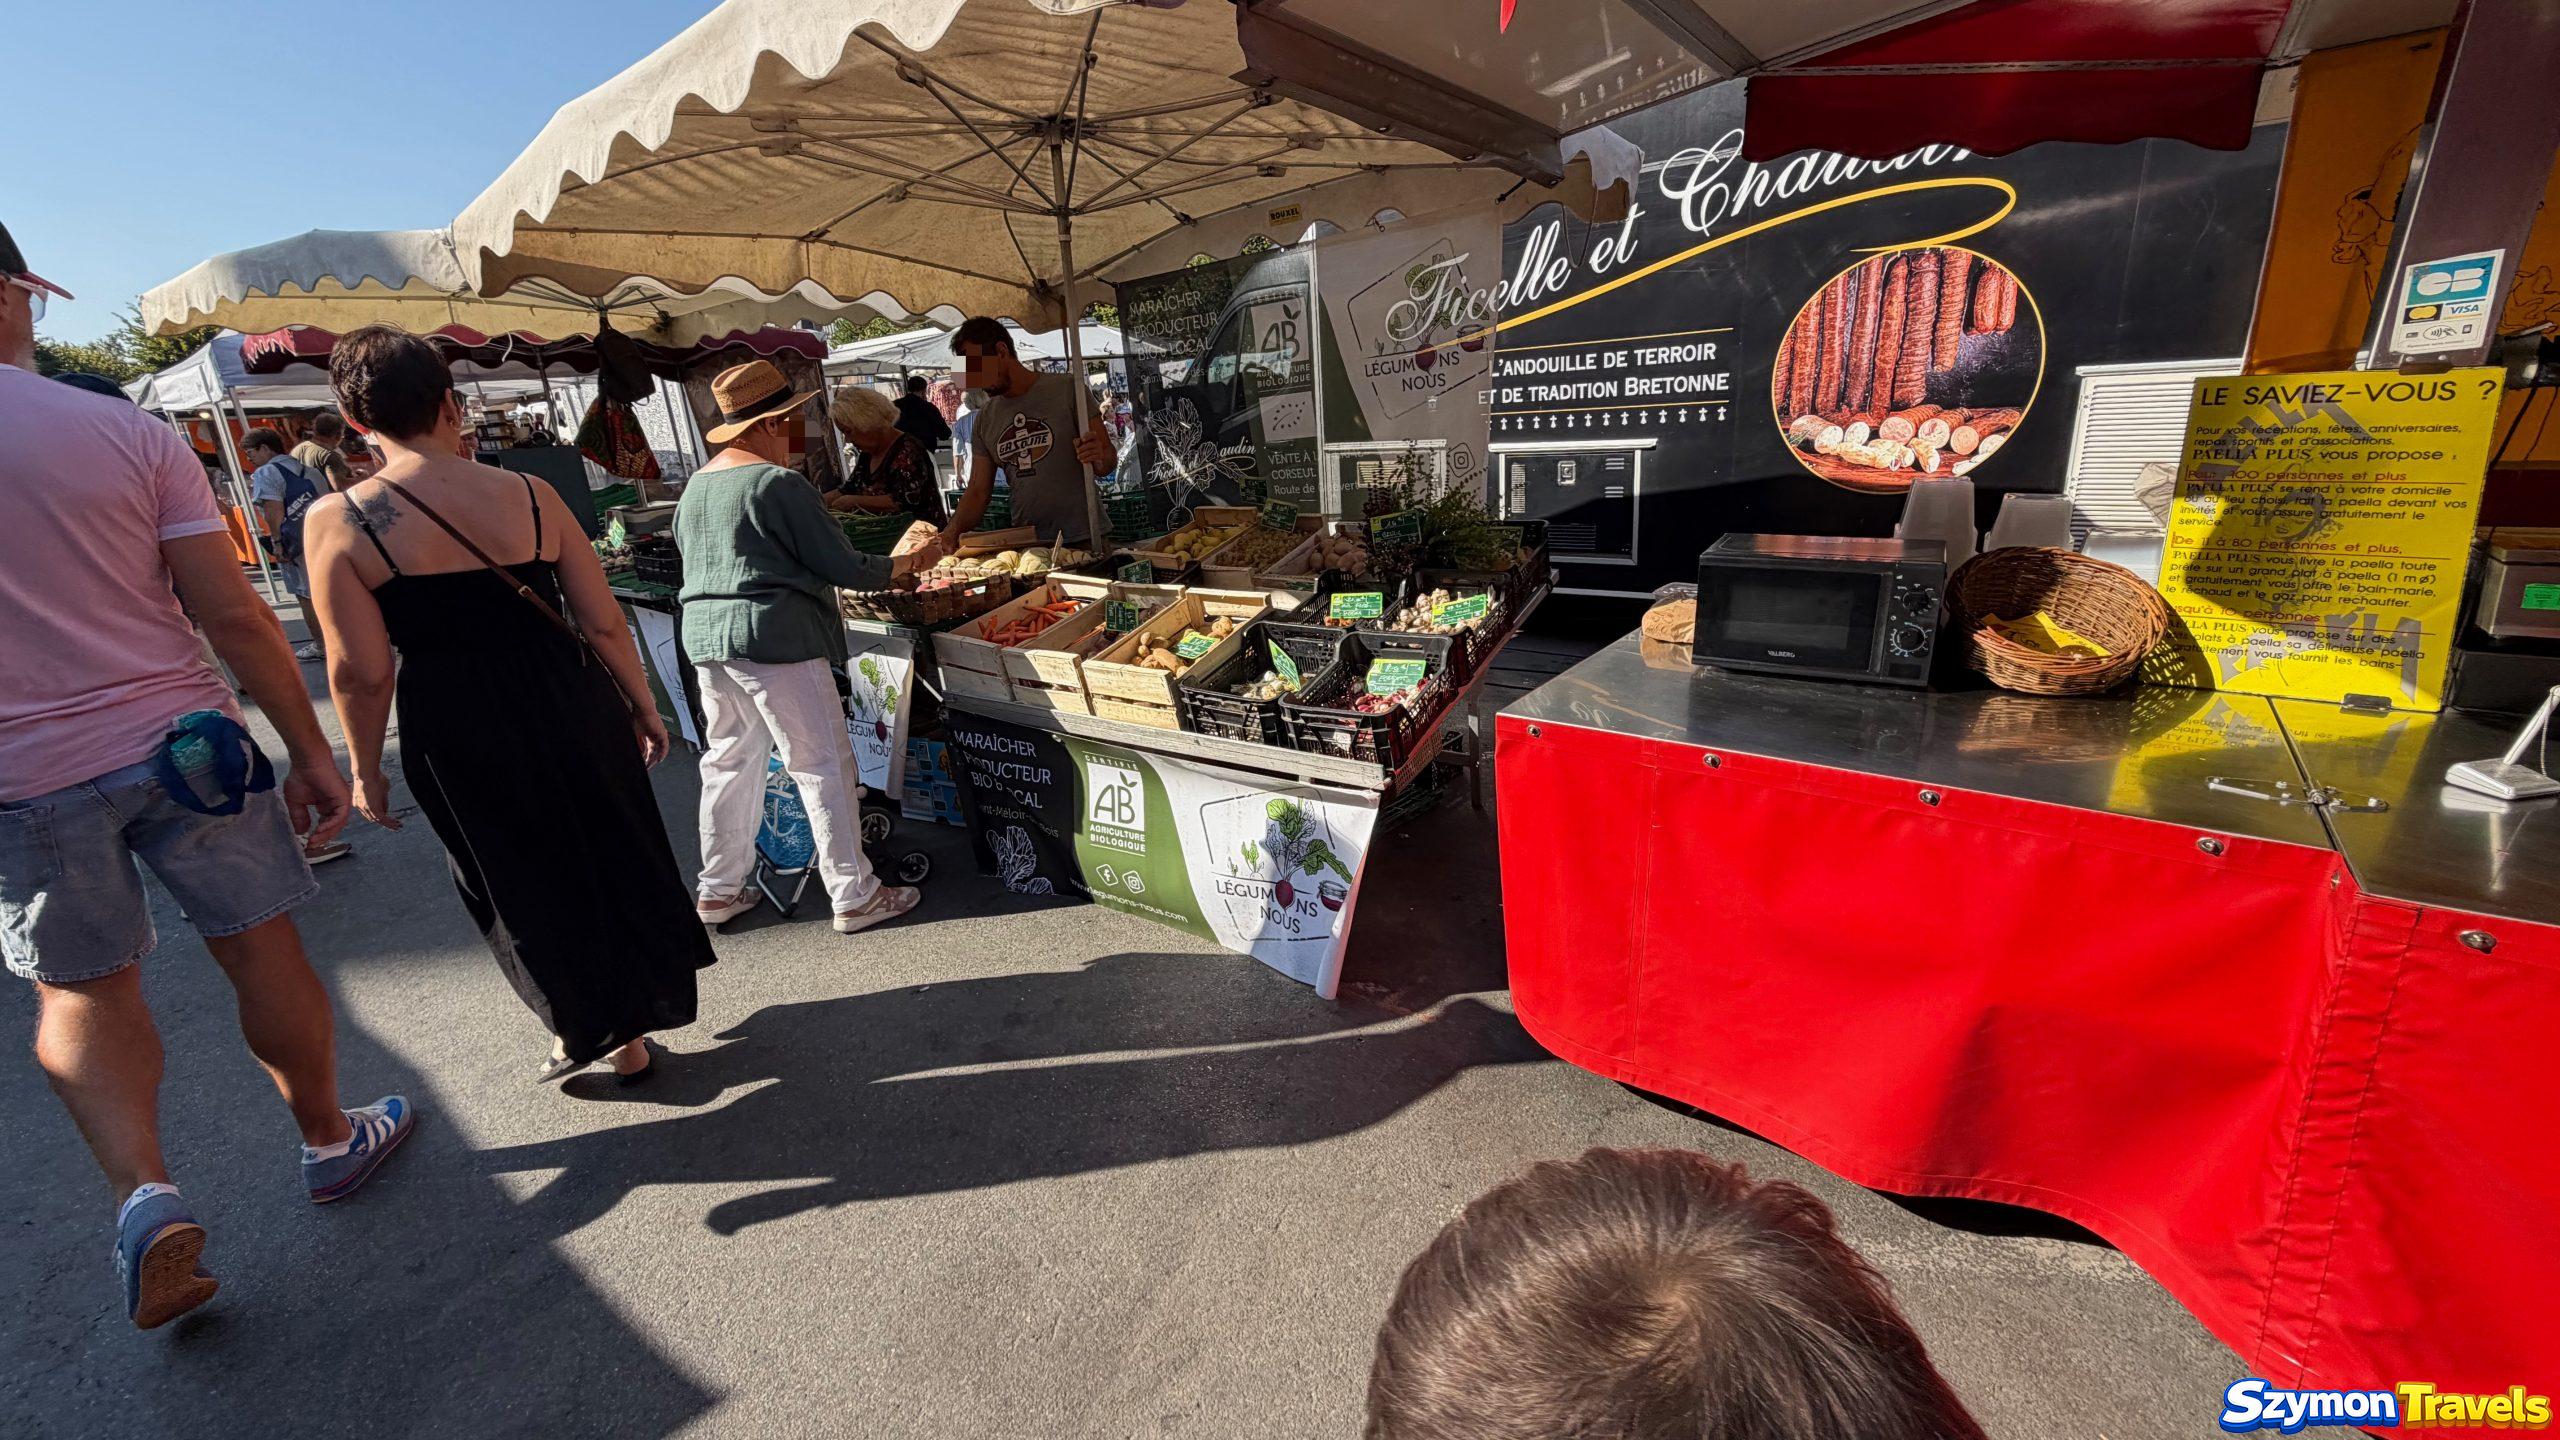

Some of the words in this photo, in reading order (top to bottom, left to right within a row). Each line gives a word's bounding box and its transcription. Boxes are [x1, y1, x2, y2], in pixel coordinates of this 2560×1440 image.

[1270, 208, 1299, 220] ROUXEL
[1386, 220, 1572, 342] Ficelle
[1589, 203, 1645, 274] et
[2417, 267, 2485, 296] CB
[2451, 304, 2479, 314] VISA
[1134, 311, 1219, 338] PRODUCTEUR
[1138, 348, 1158, 361] BIO
[1169, 337, 1213, 355] LOCAL
[1490, 353, 1597, 377] L'ANDOUILLE
[1603, 351, 1628, 368] DE
[1634, 342, 1717, 365] TERROIR
[1402, 373, 1446, 391] NOUS
[1479, 389, 1497, 405] ET
[1502, 387, 1523, 403] DE
[1528, 381, 1617, 402] TRADITION
[2201, 387, 2230, 406] LE
[2243, 381, 2458, 405] SAVIEZ-VOUS
[2478, 380, 2498, 401] ?
[2196, 426, 2223, 435] Pour
[2251, 424, 2322, 436] réceptions,
[2328, 424, 2362, 434] fêtes,
[2368, 424, 2463, 434] anniversaires,
[2194, 438, 2226, 448] repas
[2231, 436, 2275, 448] sportifs
[2281, 437, 2294, 446] et
[2299, 435, 2395, 446] d'associations.
[1268, 452, 1301, 465] VENTE
[2192, 449, 2257, 460] PAELLA
[2266, 448, 2312, 460] PLUS
[2319, 450, 2359, 460] vous
[2367, 451, 2443, 463] propose
[1271, 468, 1317, 480] CORSEUL
[2230, 470, 2260, 480] 100
[2266, 471, 2345, 483] personnes
[2352, 471, 2367, 480] et
[2375, 471, 2407, 483] plus
[1274, 486, 1300, 496] Route
[1302, 484, 1315, 495] de
[2186, 482, 2235, 492] PAELLA
[2240, 483, 2274, 492] PLUS
[2299, 484, 2330, 493] rend
[2336, 485, 2345, 494] à
[2352, 486, 2386, 495] votre
[2392, 486, 2453, 496] domicile
[2225, 495, 2245, 504] lieu
[2251, 495, 2290, 506] choisi,
[2295, 495, 2315, 506] fait
[2321, 497, 2333, 506] la
[2338, 496, 2382, 508] paella
[2388, 498, 2437, 509] devant
[2444, 500, 2468, 509] vos
[2180, 505, 2216, 515] invités
[2222, 507, 2235, 515] et
[2240, 508, 2267, 516] vous
[2273, 508, 2313, 518] assure
[2319, 507, 2407, 521] gratuitement
[2412, 510, 2425, 520] le
[2176, 536, 2194, 545] De
[2217, 537, 2226, 547] à
[2232, 538, 2252, 548] 80
[2258, 540, 2337, 553] personnes
[2345, 543, 2361, 552] et
[2367, 543, 2402, 555] plus,
[2173, 550, 2222, 562] PAELLA
[2228, 553, 2260, 563] PLUS
[2266, 556, 2295, 565] vous
[2299, 555, 2326, 566] livre
[2332, 557, 2344, 567] la
[2351, 558, 2393, 570] paella
[2400, 560, 2436, 571] toute
[2206, 565, 2223, 573] sur
[2248, 566, 2286, 578] grand
[2291, 566, 2317, 579] plat
[2322, 568, 2331, 578] à
[2337, 570, 2380, 583] paella
[2403, 574, 2416, 583] m
[2169, 574, 2180, 583] et
[2186, 575, 2261, 589] gratuitement
[2267, 580, 2296, 589] vous
[2302, 580, 2332, 591] offre
[2338, 583, 2350, 592] le
[2357, 583, 2437, 598] bain-marie,
[2166, 584, 2177, 593] le
[2182, 585, 2232, 598] réchaud
[2237, 588, 2250, 598] et
[2255, 590, 2266, 599] le
[2271, 592, 2297, 603] gaz
[2301, 594, 2332, 606] pour
[2338, 594, 2412, 608] rechauffer.
[2220, 608, 2236, 616] 10
[2245, 609, 2321, 623] personnes
[2214, 622, 2246, 633] PLUS
[2252, 625, 2282, 635] vous
[2286, 628, 2340, 641] propose
[2346, 632, 2365, 641] sur
[2371, 633, 2396, 645] des
[2194, 632, 2223, 643] plats
[2229, 635, 2236, 644] à
[2241, 636, 2281, 649] paella
[2286, 640, 2302, 649] sa
[2308, 640, 2375, 655] délicieuse
[2380, 647, 2426, 660] paella
[2255, 650, 2283, 660] vous
[2288, 652, 2329, 665] fournit
[2335, 655, 2354, 666] les
[2359, 656, 2404, 670] bains-
[954, 730, 1037, 757] MARAÎCHER
[971, 771, 992, 789] BIO
[1094, 784, 1135, 824] AB
[1090, 823, 1146, 842] AGRICULTURE
[1090, 834, 1146, 852] BIOLOGIQUE
[1260, 905, 1301, 933] NOUS
